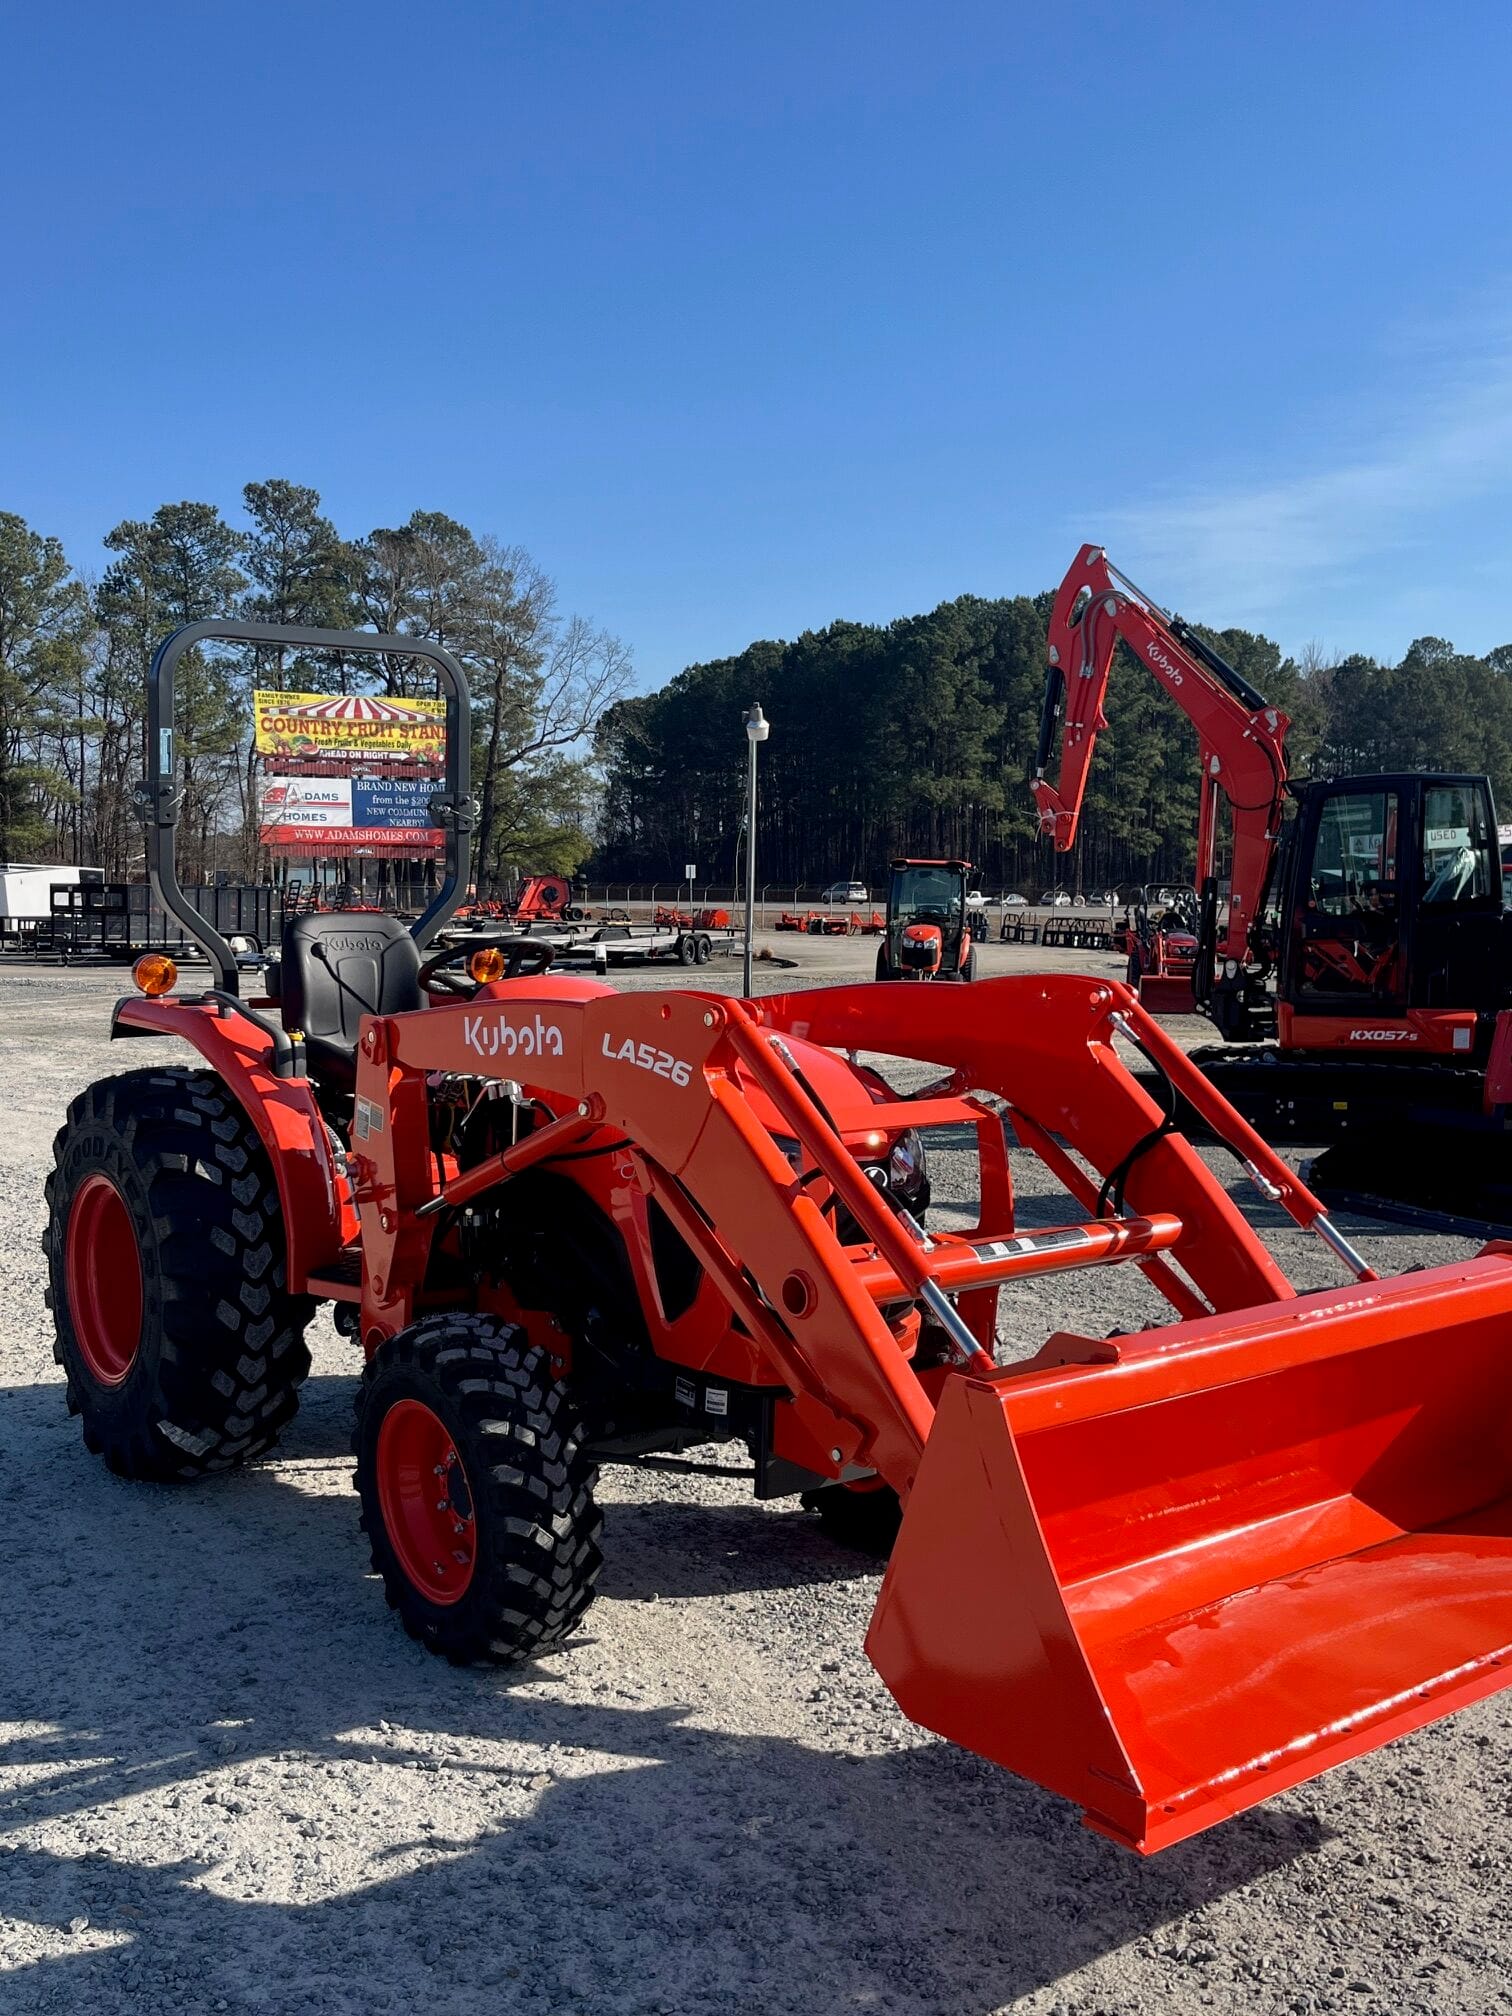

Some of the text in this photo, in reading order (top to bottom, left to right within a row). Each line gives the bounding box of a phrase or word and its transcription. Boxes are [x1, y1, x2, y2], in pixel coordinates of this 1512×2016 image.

[1146, 641, 1183, 687] Kubota
[261, 717, 341, 736] COUNTRY
[347, 722, 395, 738] FRUIT
[315, 737, 332, 746] Fresh
[361, 740, 394, 749] Vegetables
[396, 741, 411, 750] Daily
[319, 749, 347, 758] AHEAD
[363, 751, 389, 759] RIGHT
[356, 781, 392, 791] BRAND
[394, 782, 417, 792] NEW
[373, 795, 392, 804] from
[396, 796, 409, 804] the
[283, 813, 327, 821] HOMES
[367, 807, 386, 816] NEW
[294, 829, 429, 842] WWW.ADAMSHOMES.COM
[1431, 829, 1456, 841] USED
[324, 936, 383, 952] Kubota
[464, 1014, 563, 1056] Kubota
[602, 1033, 693, 1087] LA526
